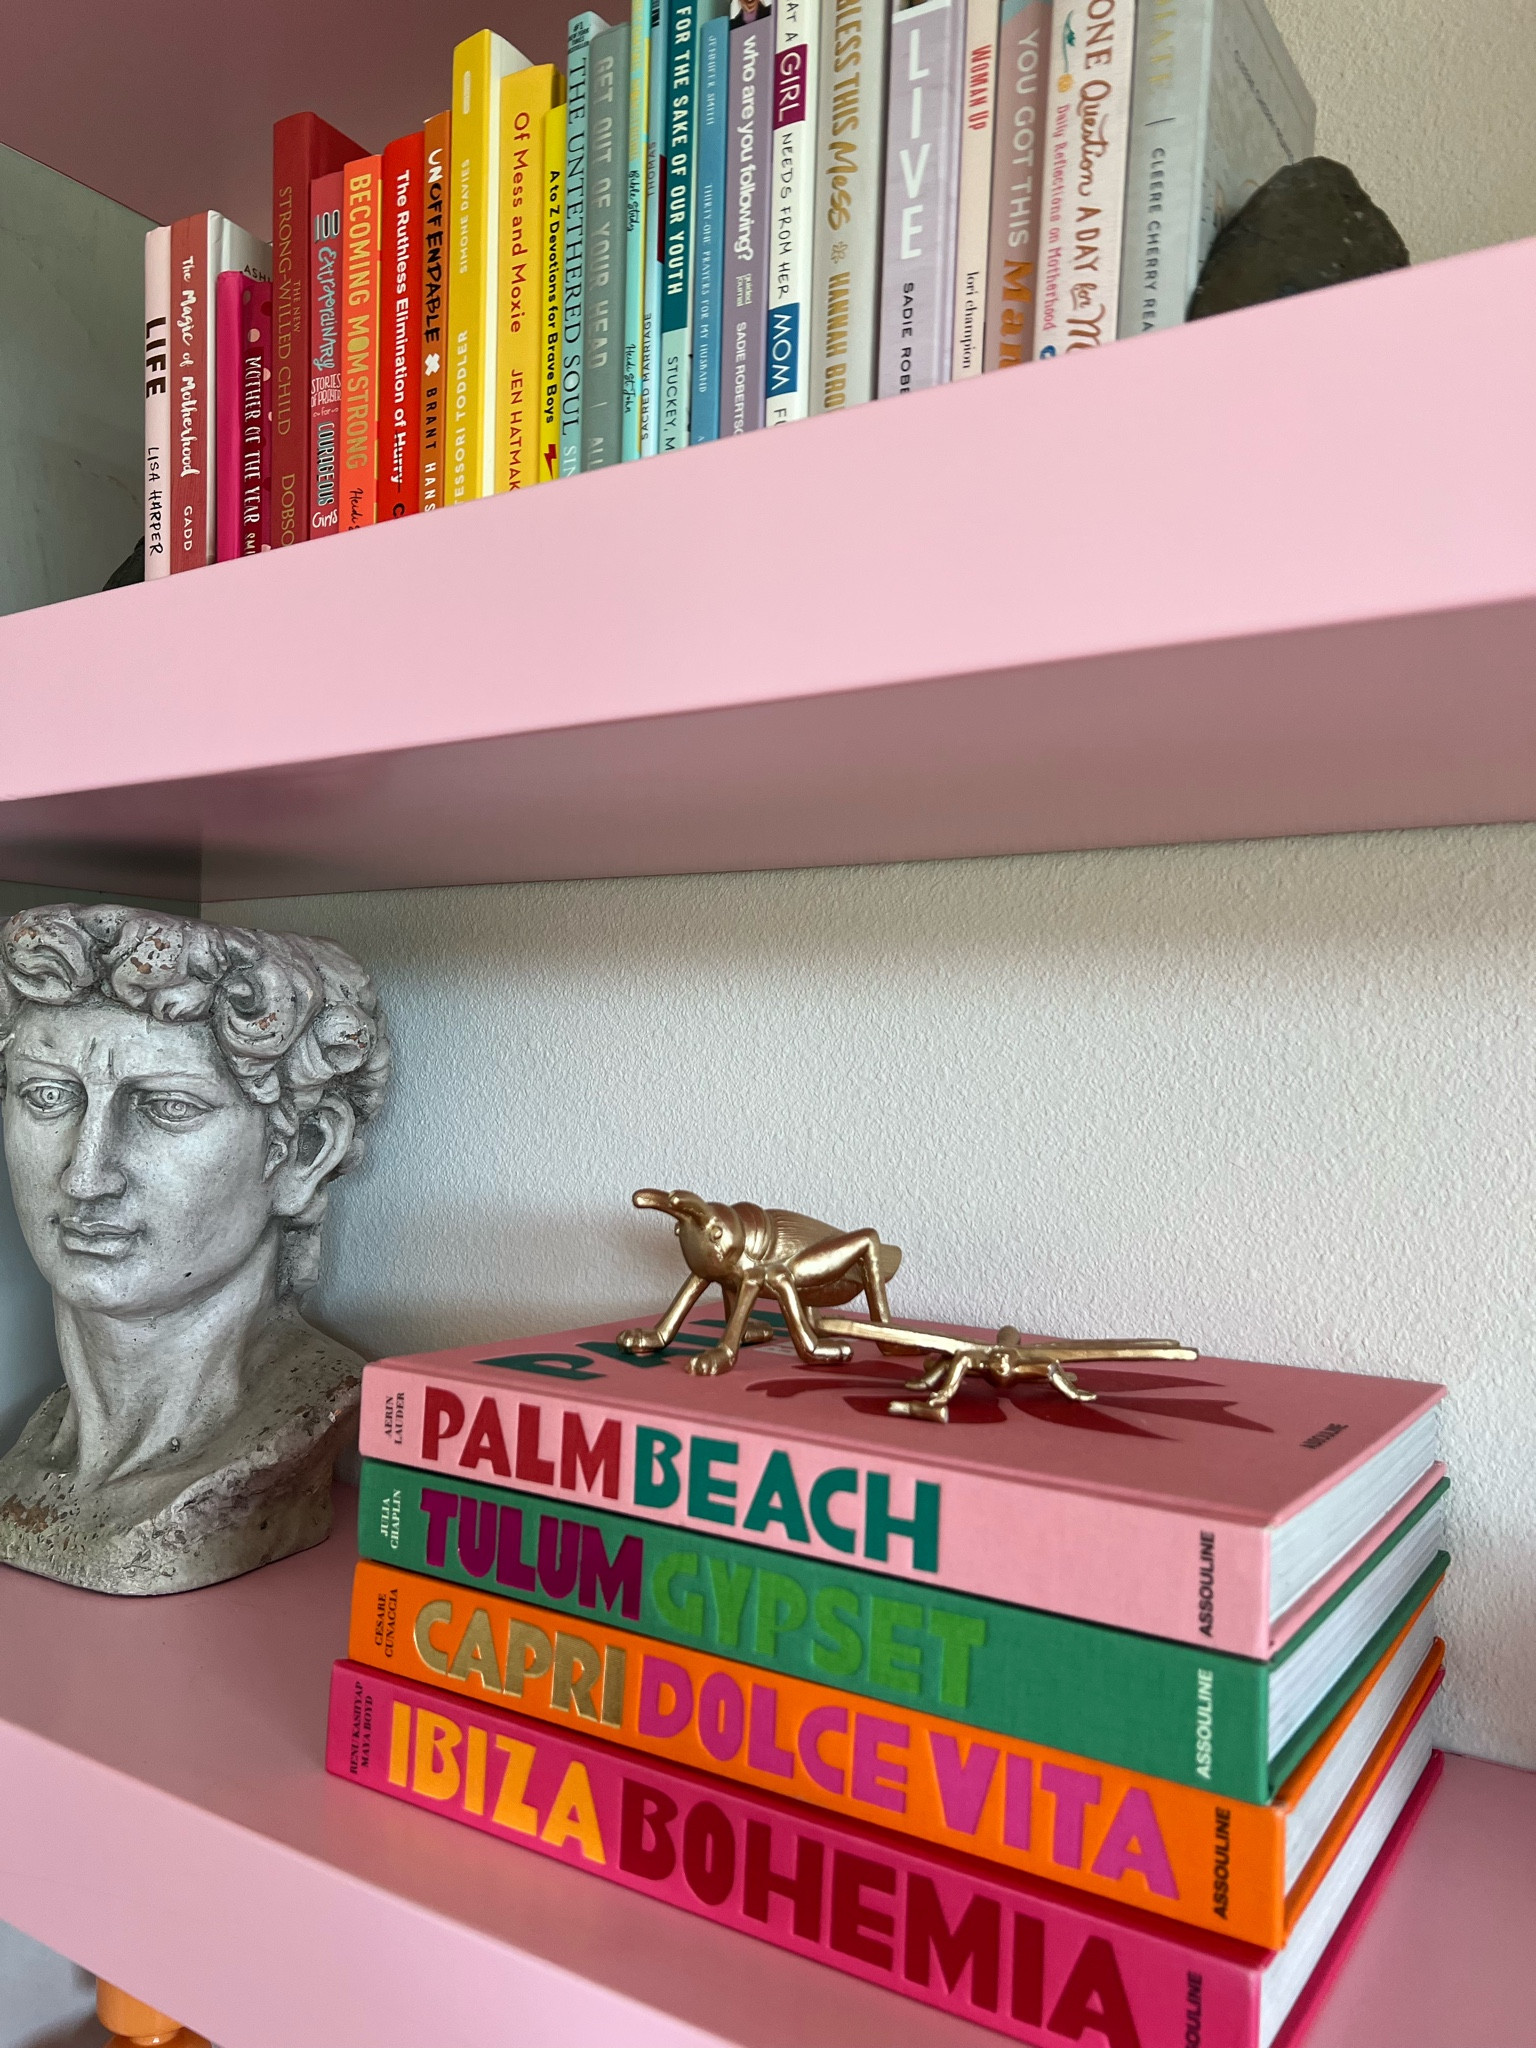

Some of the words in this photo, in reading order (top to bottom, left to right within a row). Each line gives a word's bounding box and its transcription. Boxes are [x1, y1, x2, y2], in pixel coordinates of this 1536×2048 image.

[675, 6, 692, 45] FOR
[784, 32, 798, 42] A
[1085, 0, 1115, 70] ONE
[594, 55, 614, 104] GET
[673, 50, 690, 90] THE
[708, 35, 717, 88] JENNIFER
[742, 34, 760, 81] who
[968, 44, 992, 107] WOMAN
[1016, 28, 1040, 95] YOU
[569, 57, 588, 124] THE
[706, 93, 716, 126] SMITH
[742, 85, 756, 119] are
[778, 52, 802, 122] GIRL
[832, 72, 860, 136] THIS
[513, 112, 531, 141] Of
[593, 117, 613, 167] OUT
[672, 95, 689, 148] SAKE
[736, 121, 755, 162] you
[900, 27, 931, 260] LIVE
[967, 110, 990, 130] UP
[1011, 105, 1037, 166] GOT
[1052, 103, 1072, 138] Daily
[1076, 79, 1112, 197] Question
[397, 169, 410, 206] The
[461, 158, 471, 211] DAVIES
[512, 149, 530, 208] Mess
[550, 170, 560, 182] A
[628, 169, 641, 199] Bible
[648, 142, 656, 196] THOMAS
[671, 153, 687, 177] OF
[781, 133, 793, 199] NEEDS
[825, 141, 858, 231] Mess
[1050, 141, 1069, 222] Reflections
[1148, 147, 1166, 213] CLEERE
[550, 185, 559, 202] to
[550, 205, 560, 217] Z
[592, 178, 612, 211] OF
[626, 200, 641, 232] Study
[669, 185, 687, 225] OUR
[703, 184, 713, 245] THIRTY-ONE
[734, 163, 757, 261] following?
[1008, 175, 1034, 248] THIS
[1075, 206, 1103, 223] A
[349, 173, 372, 306] BECOMING
[396, 210, 410, 294] Ruthless
[424, 148, 444, 343] UNOFFENDABLE
[460, 214, 471, 274] SIMONE
[511, 216, 528, 256] and
[564, 132, 587, 344] UNTETHERED
[590, 221, 611, 290] YOUR
[777, 206, 792, 255] FROM
[1047, 227, 1061, 243] on
[1074, 227, 1101, 271] DAY
[1144, 220, 1162, 290] CHERRY
[182, 255, 194, 282] The
[279, 186, 292, 359] STRONG-WILLED
[547, 220, 560, 302] Devotions
[668, 231, 685, 296] YOUTH
[702, 250, 711, 295] PRAYERS
[776, 262, 790, 299] HER
[966, 271, 979, 295] lori
[293, 280, 301, 303] THE
[510, 263, 527, 333] Moxie
[700, 299, 710, 320] FOR
[736, 275, 746, 307] journal
[744, 273, 753, 304] guided
[826, 271, 850, 358] HANNAH
[901, 282, 914, 338] SADIE
[1042, 246, 1062, 331] Motherhood
[1069, 282, 1098, 312] for
[177, 289, 196, 346] Magic
[293, 308, 301, 333] NEW
[547, 305, 558, 328] for
[588, 299, 609, 369] HEAD
[700, 324, 709, 339] MY
[736, 321, 747, 360] SADIE
[959, 299, 977, 368] champion
[146, 316, 167, 398] LIFE
[179, 352, 194, 367] of
[394, 296, 409, 404] Elimination
[546, 332, 558, 381] Brave
[642, 313, 653, 382] MARRIAGE
[698, 343, 708, 393] HUSBAND
[771, 313, 792, 390] MOM
[244, 356, 262, 423] MOTHER
[278, 366, 291, 436] CHILD
[311, 373, 341, 395] STORIES
[346, 314, 371, 470] MOMSTRONG
[456, 330, 468, 421] TODDLER
[510, 369, 523, 404] JEN
[562, 354, 582, 436] SOUL
[180, 375, 201, 478] Motherhood
[394, 408, 407, 427] of
[426, 387, 438, 450] BRANT
[544, 384, 557, 424] Boys
[641, 388, 650, 440] SACRED
[147, 447, 161, 482] LISA
[244, 450, 261, 482] THE
[317, 421, 335, 507] COURAGEOUS
[391, 431, 407, 484] Hurry
[243, 485, 261, 527] YEAR
[349, 487, 364, 524] Heidi
[424, 463, 436, 512] HANS
[149, 490, 163, 556] HARPER
[183, 505, 193, 551] GADD
[312, 509, 338, 528] Girls
[384, 1395, 394, 1438] AERIN
[394, 1391, 406, 1446] LAUDER
[421, 1385, 622, 1500] PALM
[634, 1424, 941, 1574] BEACH
[380, 1497, 391, 1538] JULIA
[390, 1488, 402, 1550] CHAPLIN
[420, 1487, 644, 1621] TULUM
[650, 1551, 987, 1710] GYPSET
[1198, 1530, 1215, 1638] ASSOULINE
[374, 1592, 387, 1647] CESARE
[384, 1588, 399, 1658] CUNACCIA
[353, 1680, 363, 1739] KASHYAP
[364, 1695, 373, 1731] BOYD
[1195, 1667, 1214, 1780] ASSOULINE
[350, 1742, 359, 1775] RENU
[361, 1733, 371, 1768] MAYA
[413, 1599, 627, 1730] CAPRI
[638, 1653, 911, 1815] DOLCE
[928, 1730, 1180, 1902] VITA
[388, 1699, 606, 1865] IBIZA
[618, 1776, 1142, 2048] BOHEMIA
[1213, 1806, 1231, 1922] ASSOULINE
